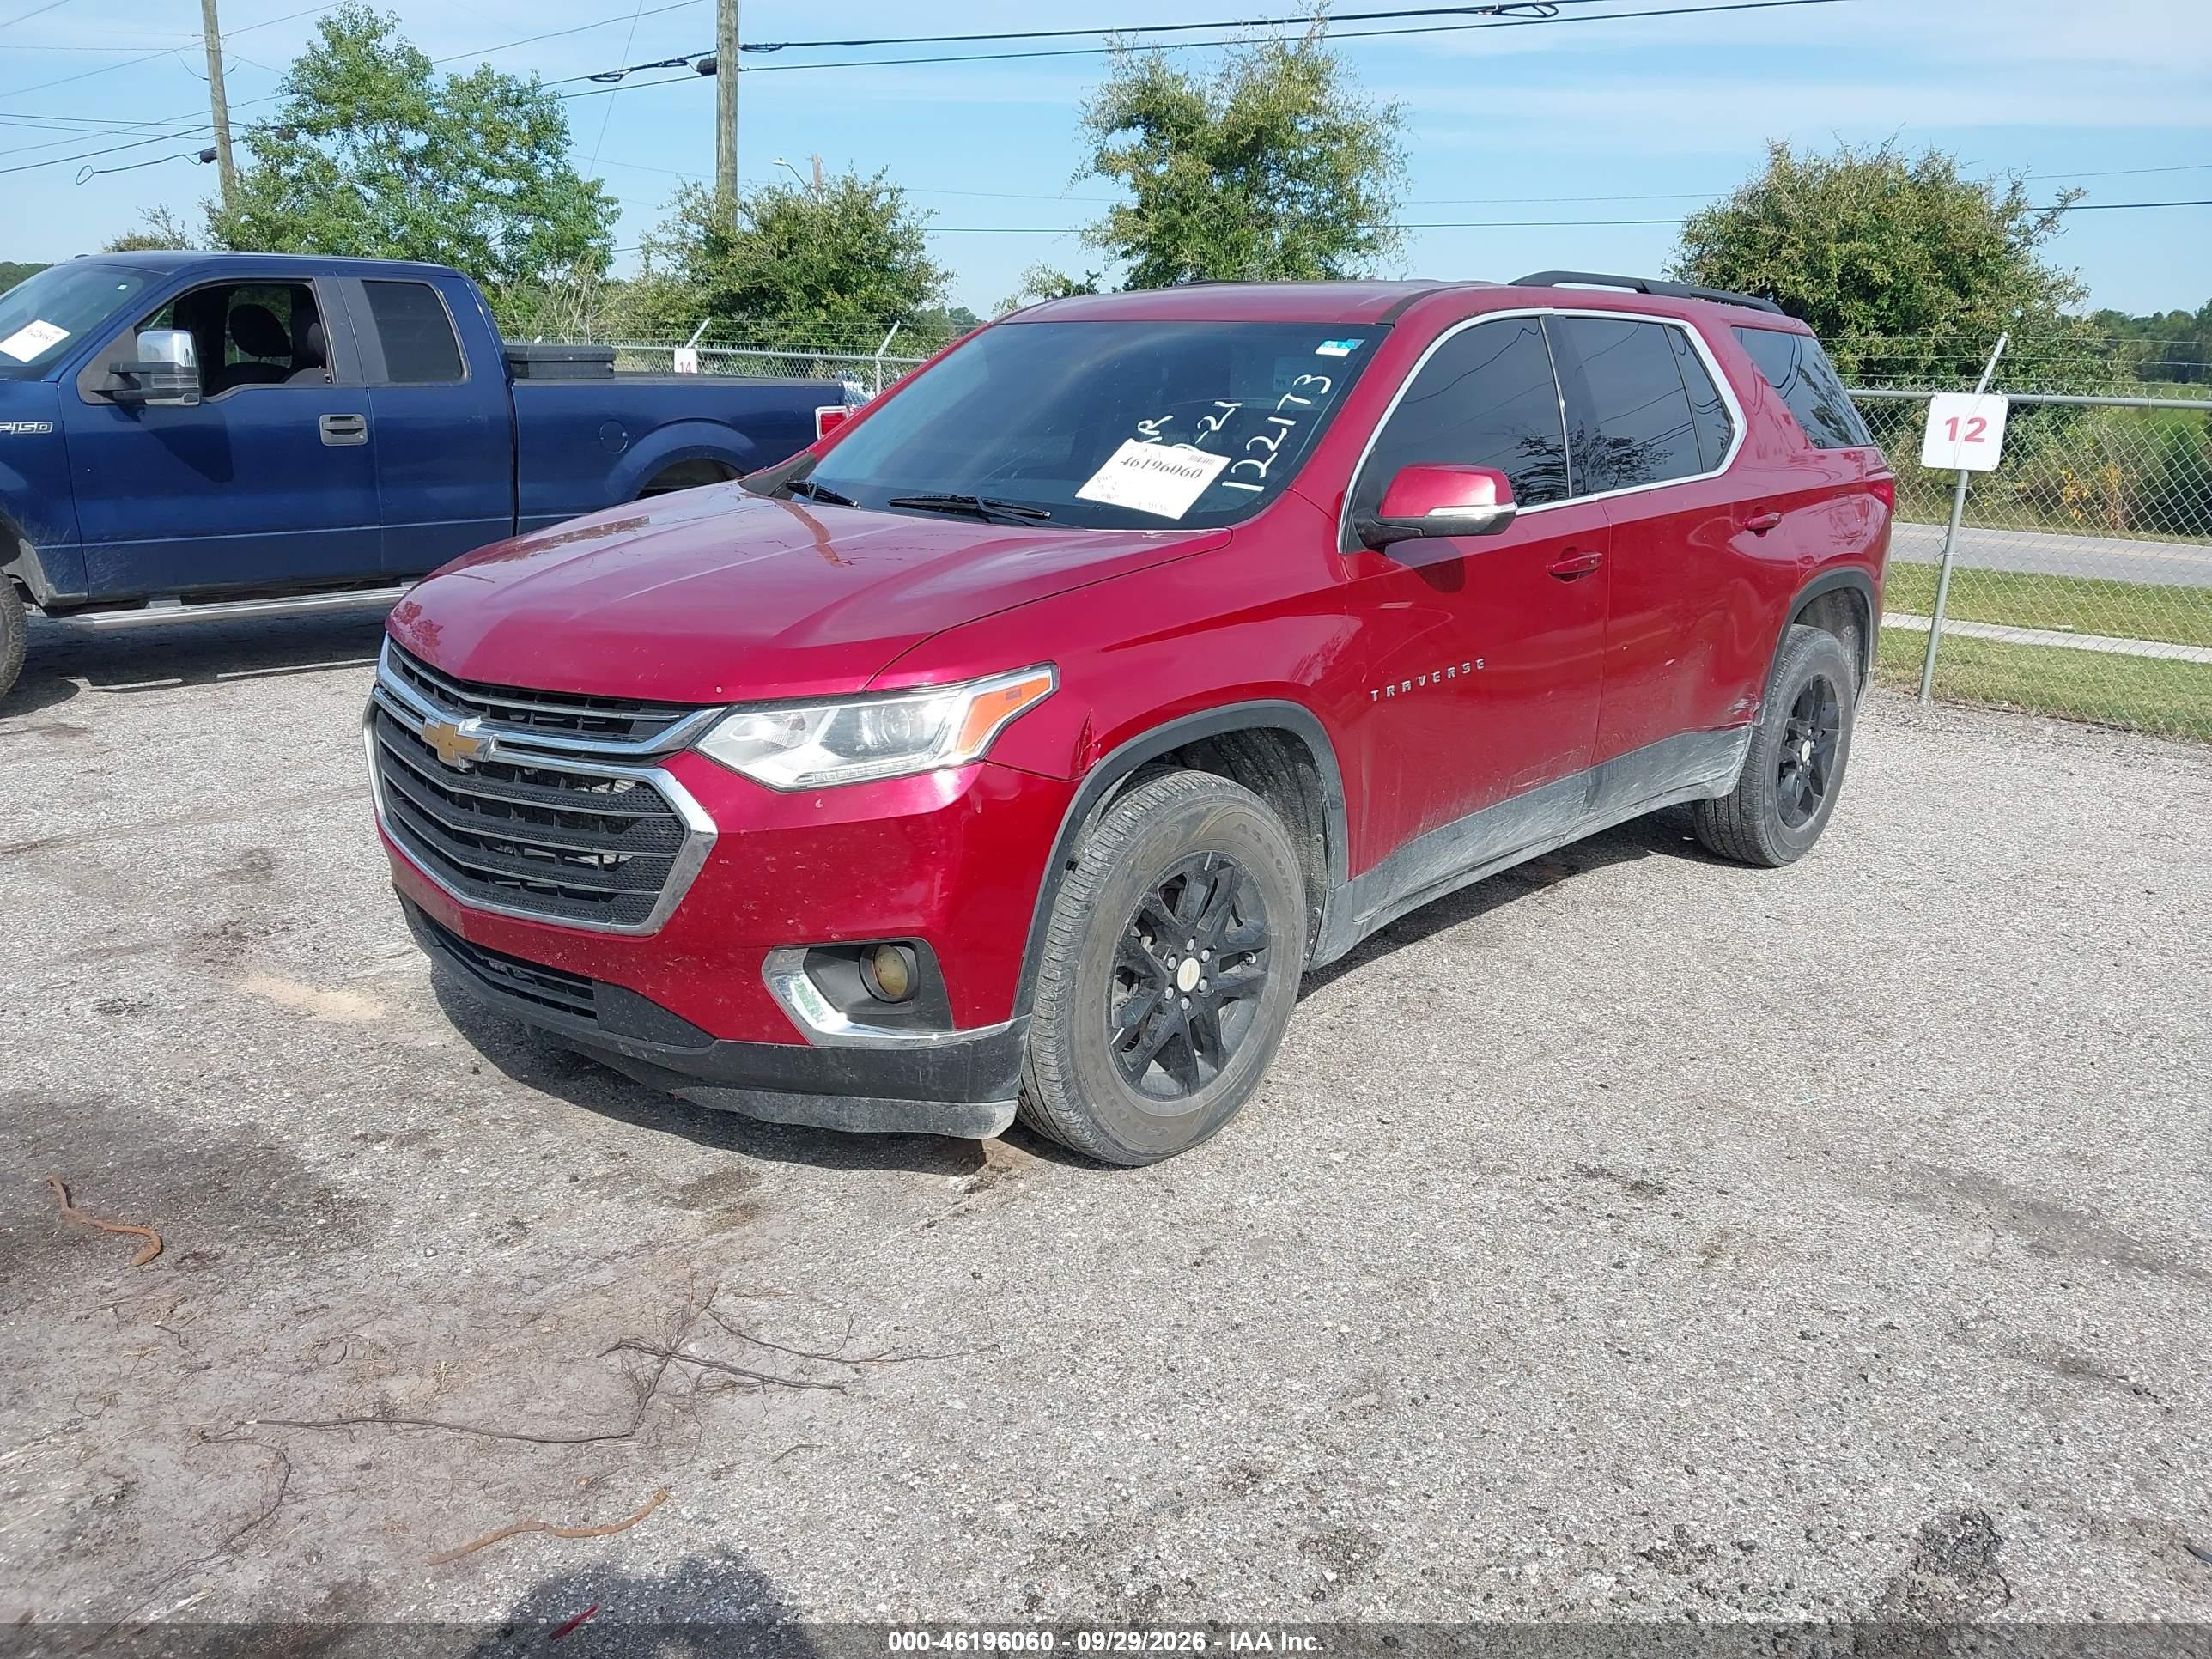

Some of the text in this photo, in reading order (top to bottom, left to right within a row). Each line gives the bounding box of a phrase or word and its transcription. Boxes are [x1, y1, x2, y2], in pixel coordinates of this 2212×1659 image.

[680, 361, 692, 374] 14
[0, 421, 53, 434] F-150
[1220, 374, 1332, 492] 122173
[1945, 416, 1987, 442] 12
[1121, 456, 1204, 479] 46196060
[1370, 658, 1486, 702] TRAVERSE
